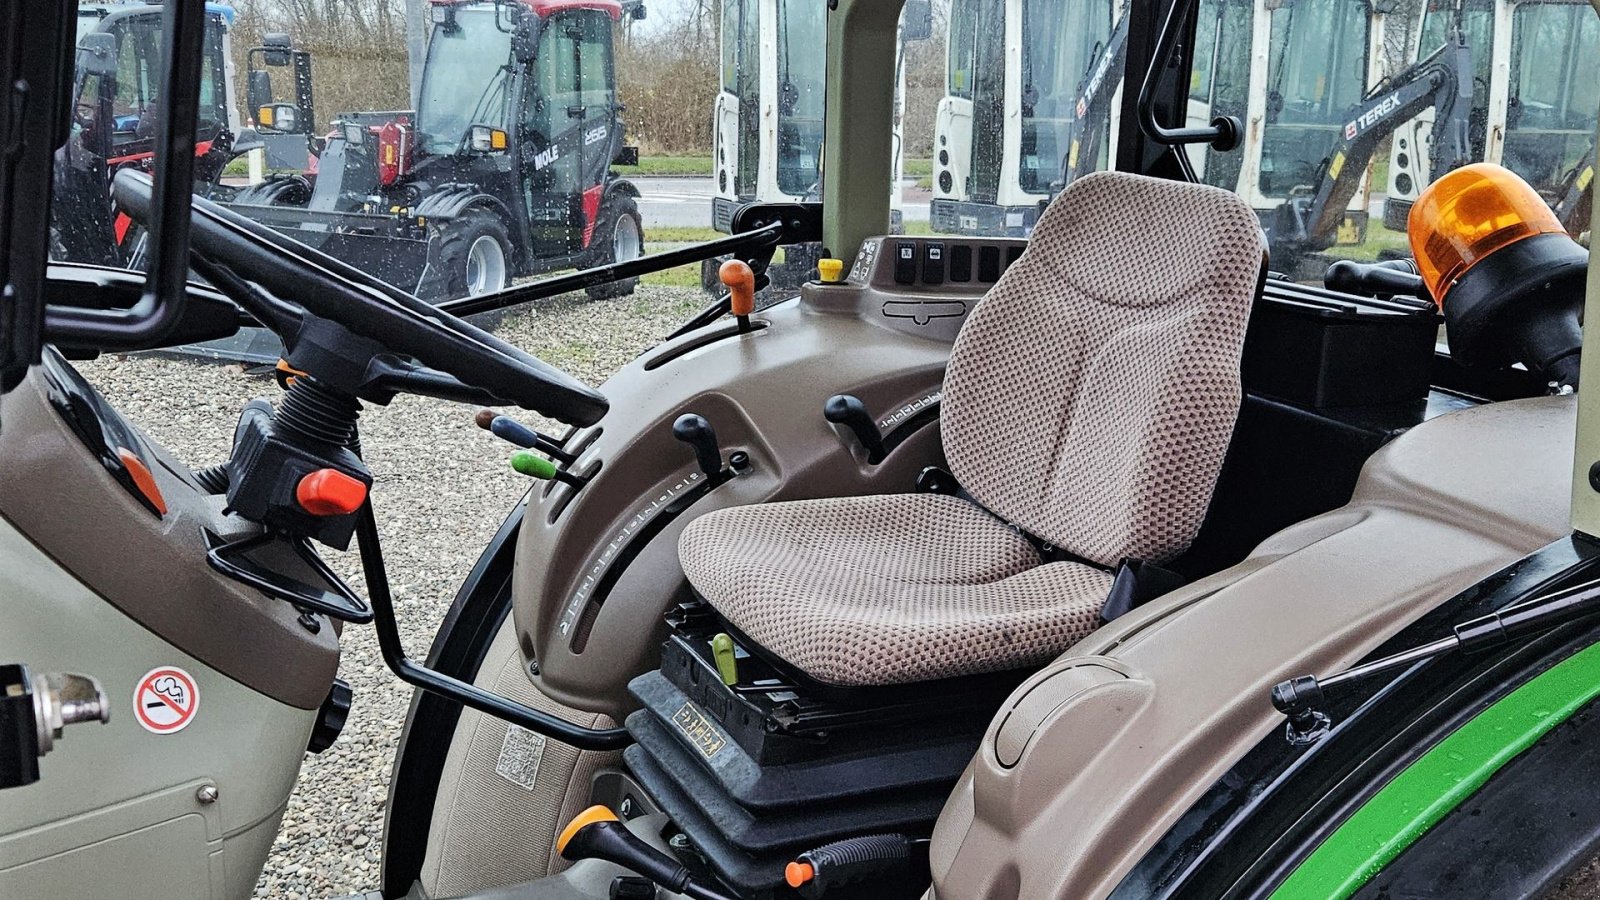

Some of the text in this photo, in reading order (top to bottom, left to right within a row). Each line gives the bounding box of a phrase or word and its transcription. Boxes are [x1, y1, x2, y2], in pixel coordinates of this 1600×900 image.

[1084, 46, 1113, 100] TEREX
[1357, 91, 1401, 130] TEREX
[534, 144, 559, 171] MOLE
